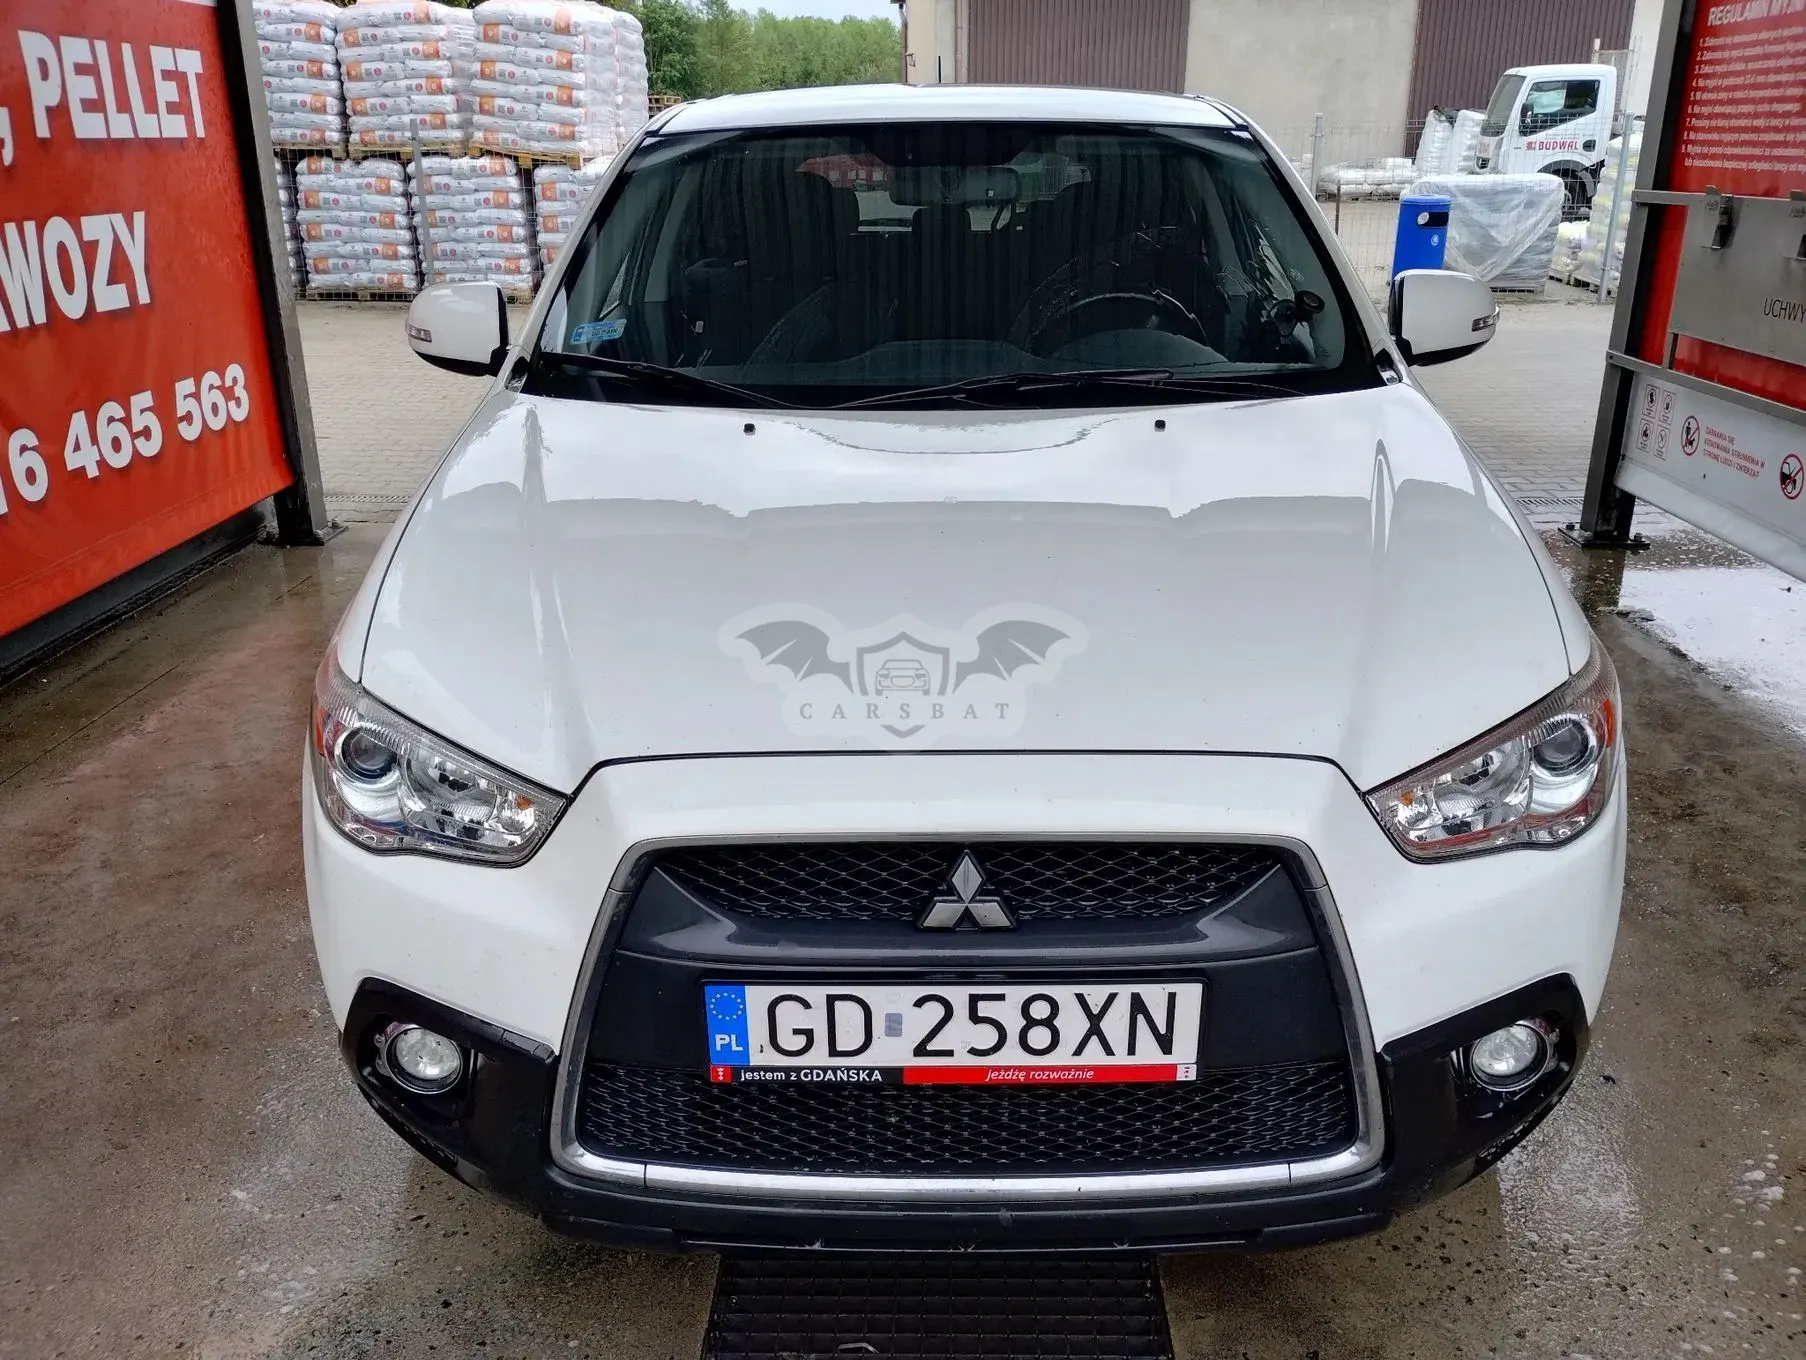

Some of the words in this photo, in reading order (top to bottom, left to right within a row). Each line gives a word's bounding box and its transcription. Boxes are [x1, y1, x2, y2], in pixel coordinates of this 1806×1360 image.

[1708, 0, 1769, 26] REGULAMIN
[17, 30, 205, 139] PELLET
[64, 390, 163, 479] 465
[175, 363, 250, 441] 563
[767, 992, 874, 1059] GD
[912, 991, 1178, 1059] 258XN
[715, 1034, 744, 1052] PL
[740, 1069, 785, 1081] jestem
[789, 1072, 797, 1080] z
[800, 1068, 882, 1082] GDAŃSKA
[985, 1067, 1026, 1082] jeżdżę
[1028, 1068, 1095, 1081] rozważnie
